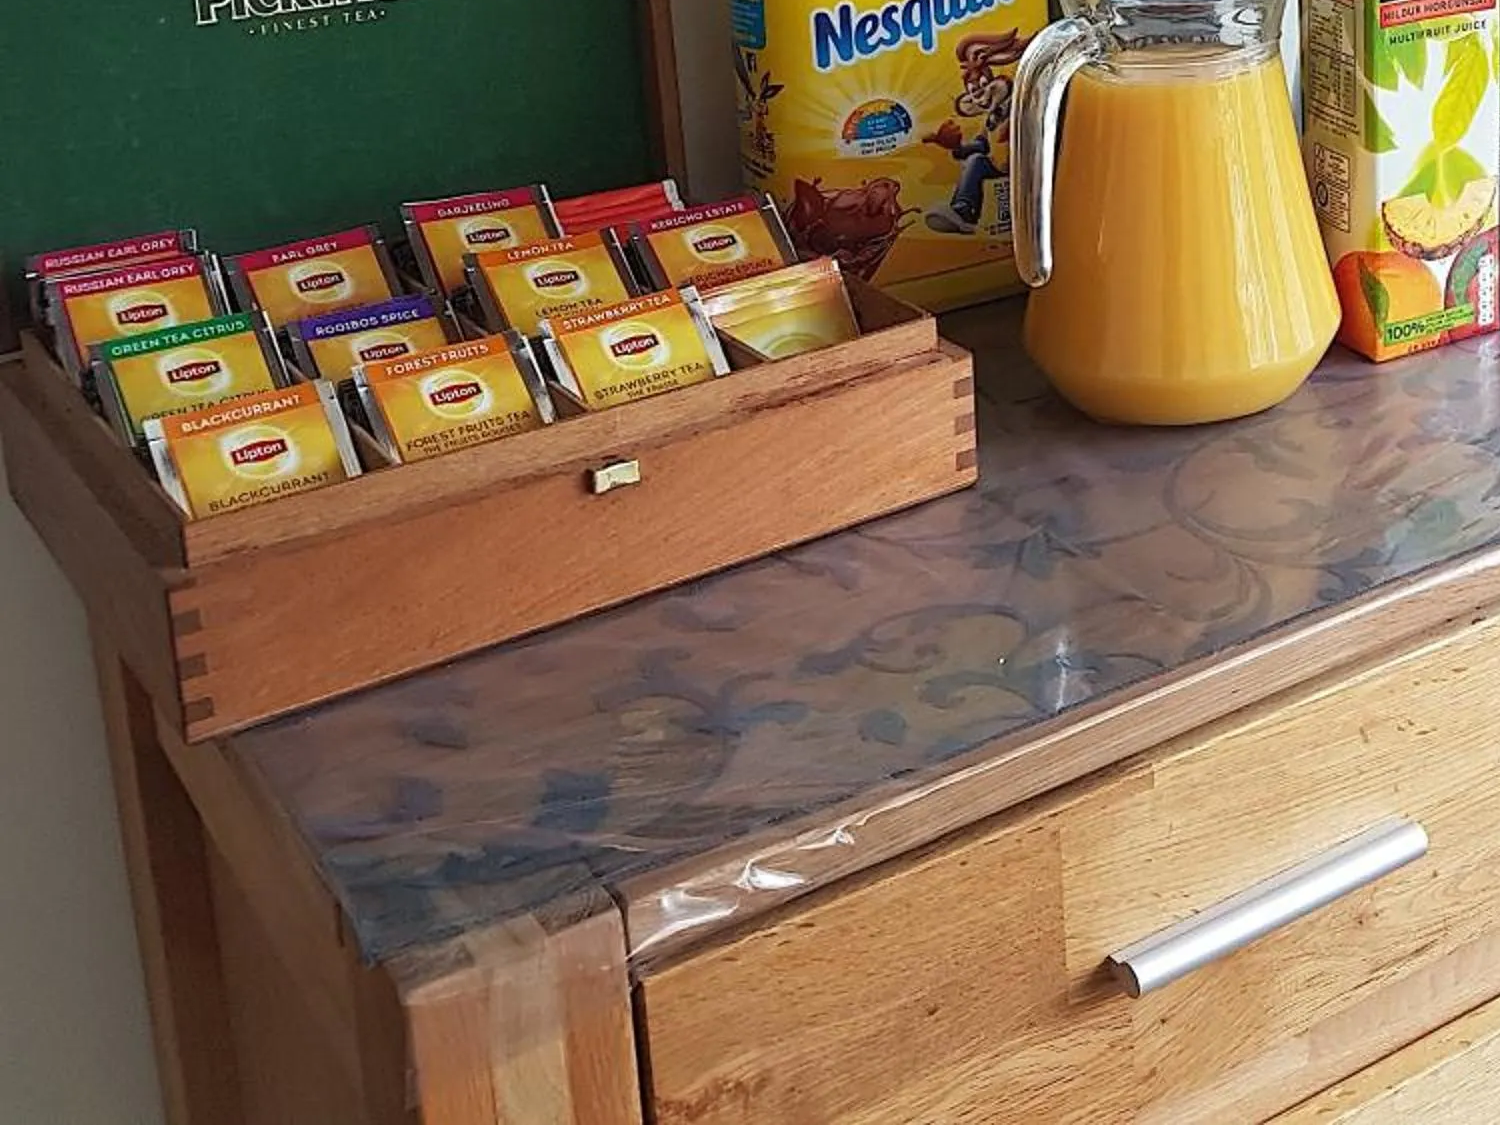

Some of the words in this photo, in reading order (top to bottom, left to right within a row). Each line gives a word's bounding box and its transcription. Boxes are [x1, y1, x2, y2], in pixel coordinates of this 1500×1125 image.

[343, 10, 377, 24] TEA
[1454, 20, 1488, 33] JUICE
[437, 198, 510, 218] DARJEELING
[469, 229, 507, 243] Lipton
[696, 237, 734, 252] Lipton
[45, 249, 104, 270] RUSSIAN
[107, 244, 140, 259] EARL
[141, 236, 176, 252] GREY
[272, 250, 303, 264] EARL
[305, 241, 338, 255] GREY
[506, 245, 552, 261] LEMON
[553, 241, 575, 253] TEA
[63, 276, 126, 295] RUSSIAN
[127, 270, 157, 285] EARL
[158, 262, 195, 277] GREY
[300, 273, 340, 290] Lipton
[538, 273, 576, 287] Lipton
[120, 305, 164, 324] Lipton
[315, 317, 379, 337] ROOIBOS
[380, 308, 421, 325] SPICE
[563, 302, 648, 330] STRAWBERRY
[648, 295, 672, 307] TEA
[111, 340, 160, 357] GREEN
[163, 332, 193, 345] TEA
[192, 320, 245, 339] CITRUS
[1387, 321, 1425, 341] 100%
[363, 344, 405, 361] Lipton
[614, 336, 656, 355] Lipton
[385, 355, 438, 376] FOREST
[440, 343, 489, 362] FRUITS
[679, 362, 705, 375] TEA
[172, 362, 217, 382] Lipton
[434, 384, 478, 405] Lipton
[181, 393, 301, 434] BLACKCURRANT
[406, 429, 457, 452] FOREST
[506, 410, 532, 422] TEA
[234, 441, 284, 463] Lipton
[208, 471, 331, 513] BLACKCURRANT
